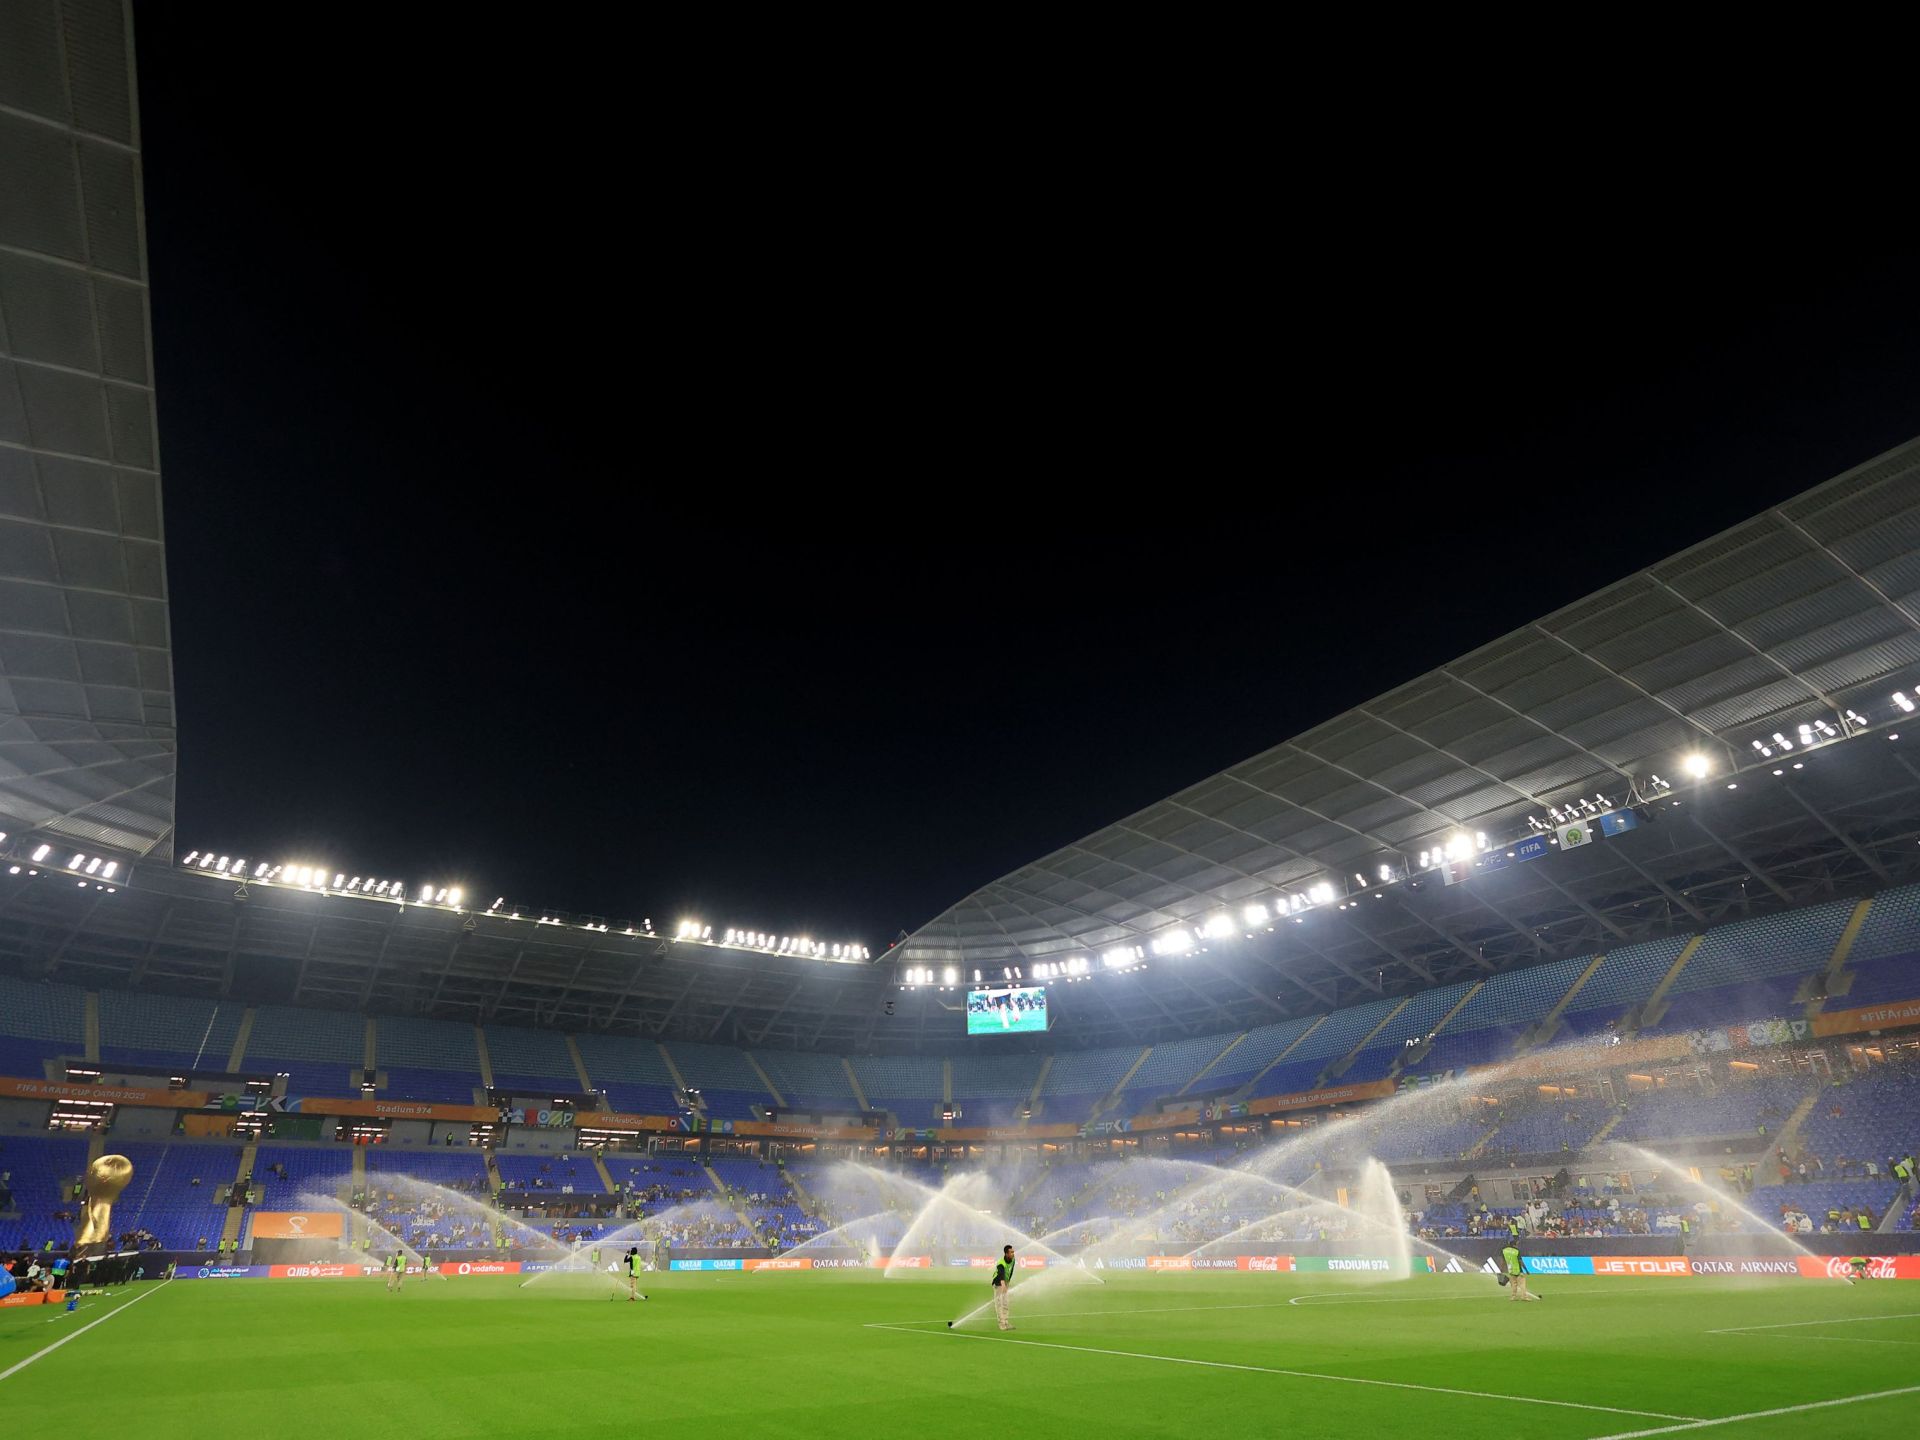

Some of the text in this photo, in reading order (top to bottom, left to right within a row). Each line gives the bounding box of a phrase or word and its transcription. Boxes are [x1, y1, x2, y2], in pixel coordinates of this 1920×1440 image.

[1520, 842, 1541, 855] FIFA
[16, 1084, 37, 1093] FIFA
[41, 1085, 69, 1096] ARAB
[71, 1088, 90, 1097] CUP
[93, 1090, 121, 1099] QATAR
[1278, 1099, 1290, 1107] FIFA
[1291, 1097, 1307, 1105] ARAB
[1308, 1094, 1320, 1103] CUP
[1320, 1092, 1337, 1101] QATAR
[375, 1104, 433, 1115] Stadium 974
[472, 1264, 504, 1273] vodafone
[678, 1260, 702, 1268] QATAR
[713, 1260, 736, 1268] QATAR
[813, 1259, 839, 1268] QATAR
[1147, 1259, 1190, 1268] JETOUR
[1191, 1259, 1237, 1269] QATAR AIRWAYS
[1328, 1259, 1390, 1270] STADIUM 974
[1532, 1258, 1569, 1271] QATAR
[1597, 1261, 1686, 1273] JETOUR
[1691, 1261, 1798, 1274] QATAR AIRWAYS
